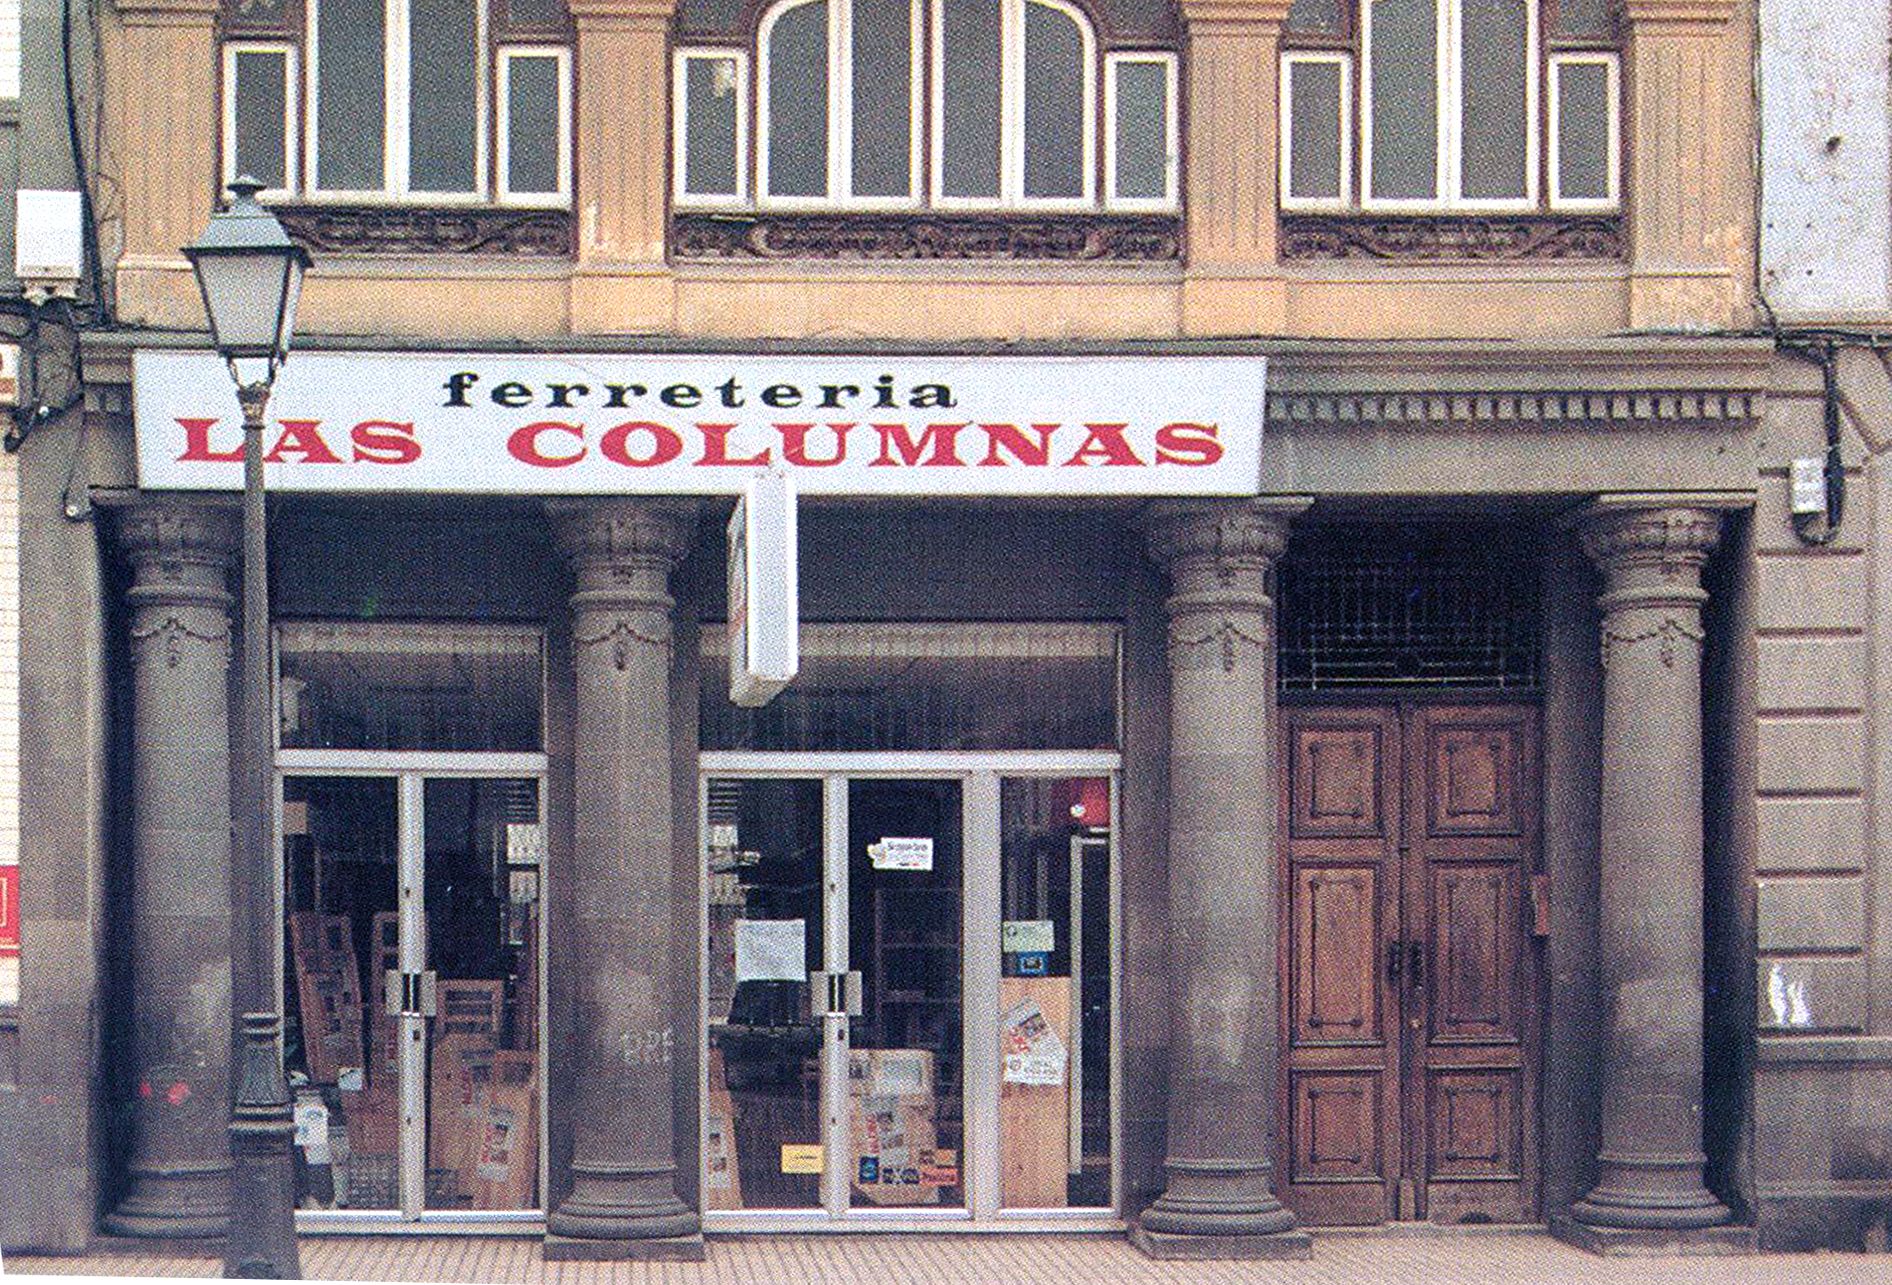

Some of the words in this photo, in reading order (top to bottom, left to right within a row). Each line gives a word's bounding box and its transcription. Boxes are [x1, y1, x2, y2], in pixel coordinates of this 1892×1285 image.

[442, 371, 957, 408] ferreteria
[174, 417, 422, 466] LAS
[506, 420, 1225, 469] COLUMNAS
